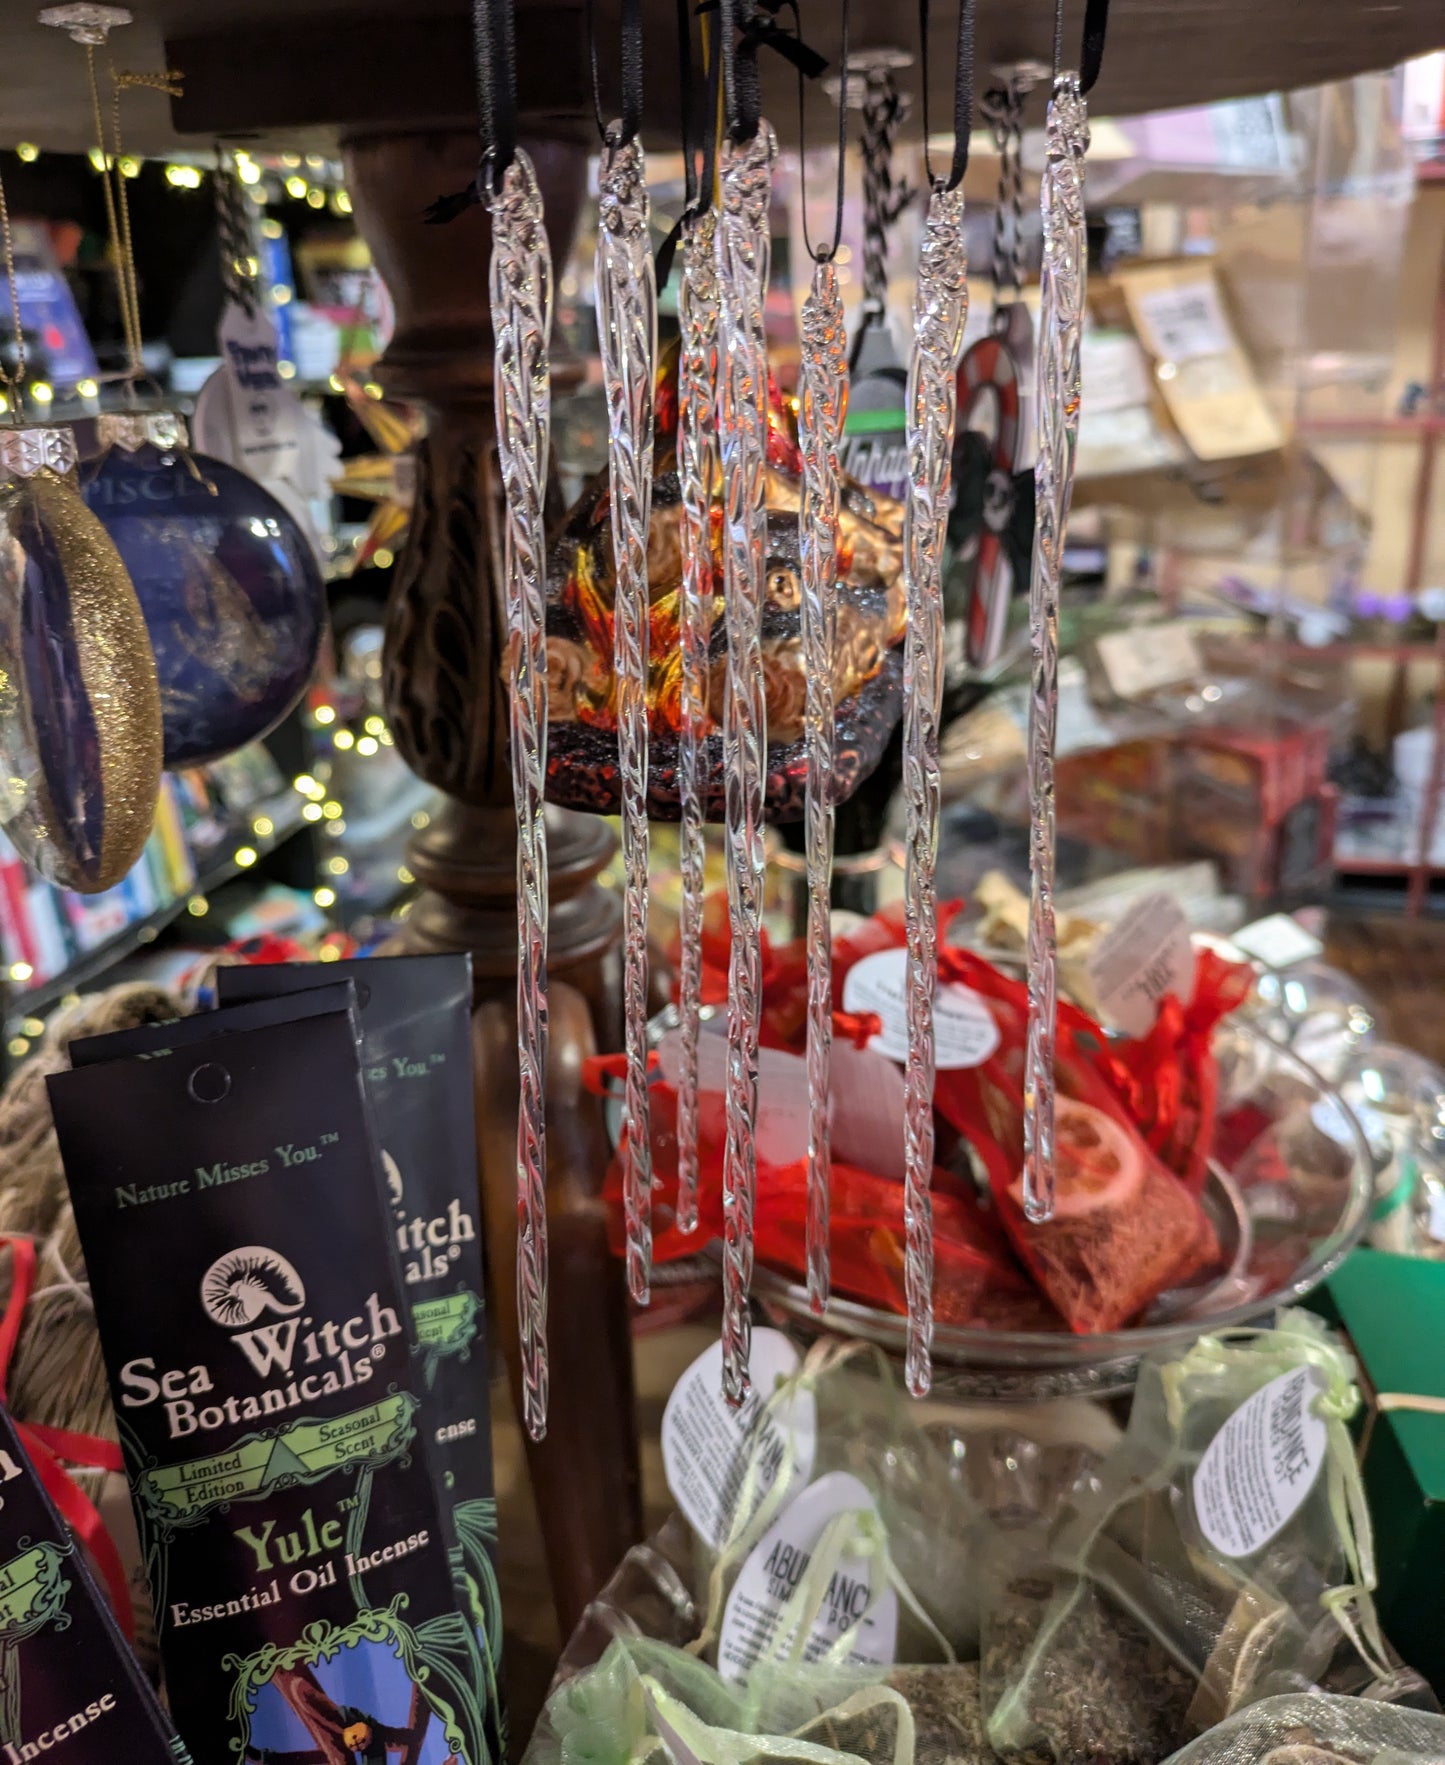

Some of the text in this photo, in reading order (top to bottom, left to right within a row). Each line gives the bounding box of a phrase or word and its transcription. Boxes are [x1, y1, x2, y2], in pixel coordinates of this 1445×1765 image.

[115, 1180, 190, 1208] Nature
[195, 1159, 269, 1190] Misses
[396, 1199, 475, 1252] itch
[120, 1292, 402, 1408] Sea Witch
[319, 1408, 381, 1442] Seasonal
[335, 1433, 376, 1459] Scent
[180, 1453, 242, 1483] Limited
[186, 1480, 244, 1504] Edition
[171, 1530, 429, 1626] Essential Oil Incense
[764, 1539, 874, 1626] ABUANC
[3, 1692, 117, 1765] Incense
